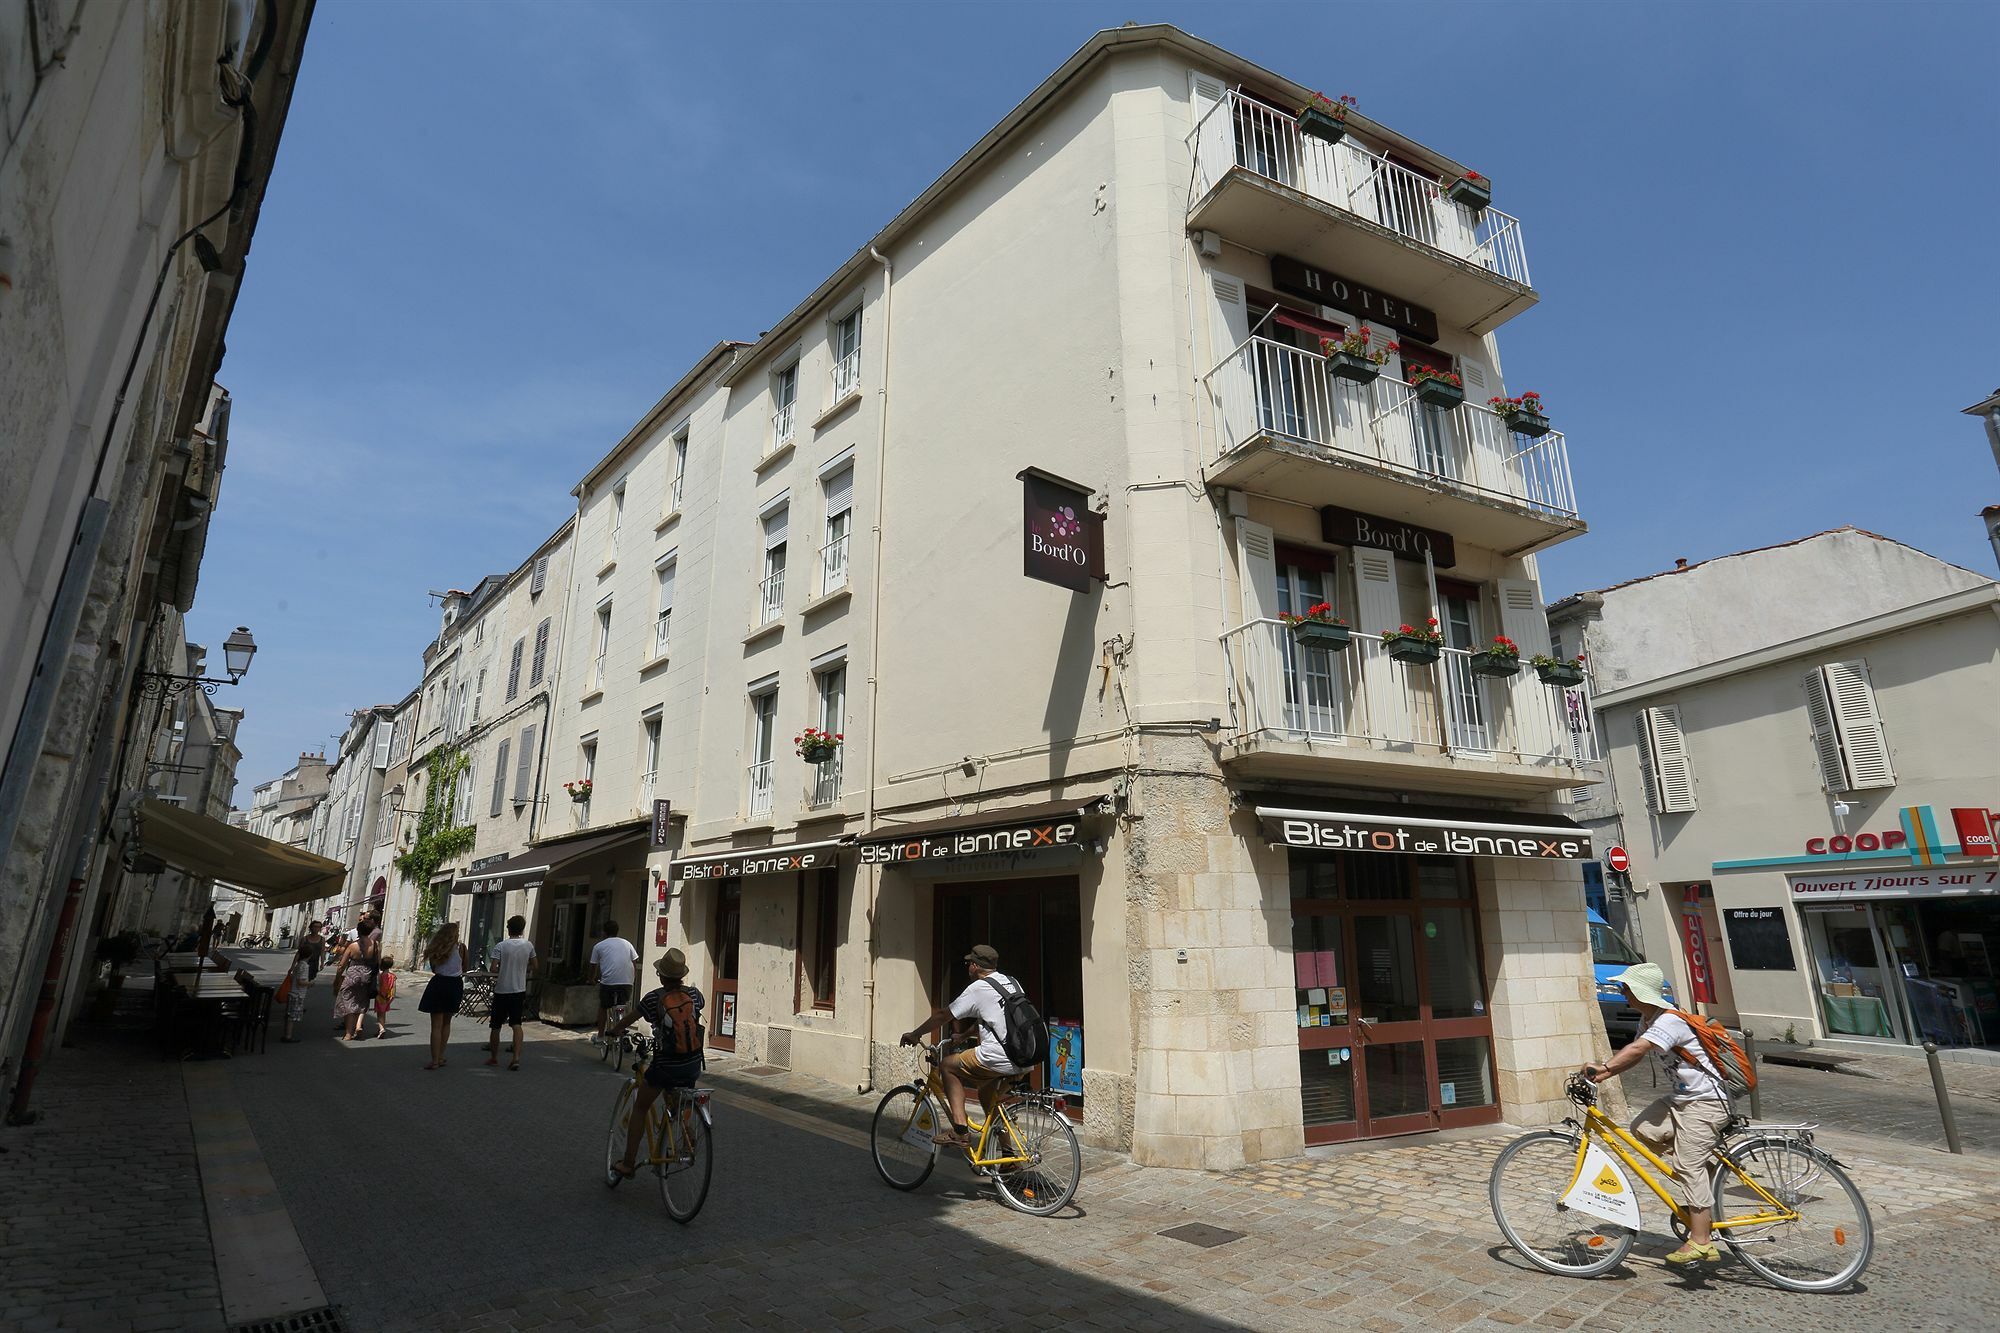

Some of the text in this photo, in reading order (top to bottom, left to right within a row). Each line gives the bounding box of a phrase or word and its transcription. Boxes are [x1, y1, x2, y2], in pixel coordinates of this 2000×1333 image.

[1304, 269, 1417, 327] HOTEL
[1031, 533, 1086, 566] Bord'O
[1355, 516, 1431, 556] Bord'O
[860, 838, 931, 864] Bistrot
[932, 846, 949, 857] de
[954, 823, 1075, 855] l'annexe
[1283, 820, 1579, 858] Bistrot de l'annexe
[1805, 830, 1906, 855] COOP
[682, 853, 815, 880] Bistrot de l'annexe
[1794, 880, 1857, 893] Ouvert
[1937, 872, 1977, 885] sur
[1984, 871, 1998, 884] 7
[1750, 910, 1759, 918] du
[1759, 910, 1773, 919] jour
[1689, 917, 1706, 983] COOP
